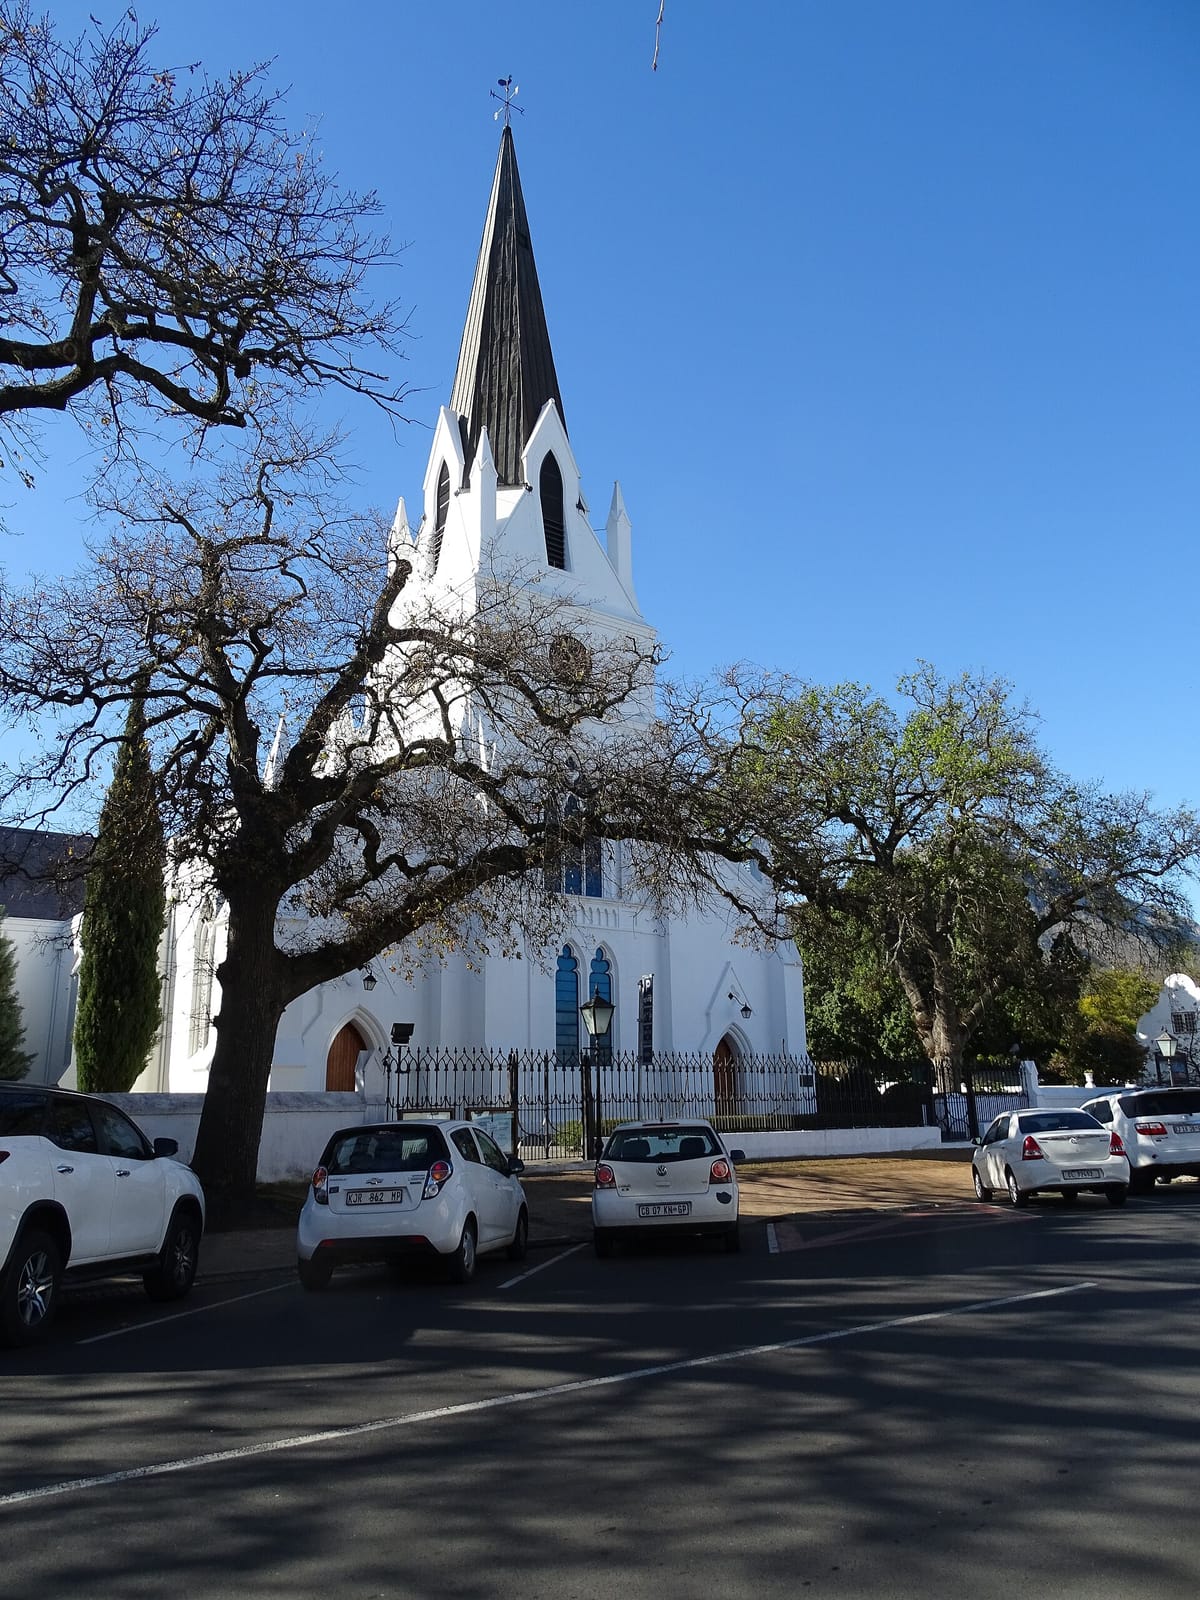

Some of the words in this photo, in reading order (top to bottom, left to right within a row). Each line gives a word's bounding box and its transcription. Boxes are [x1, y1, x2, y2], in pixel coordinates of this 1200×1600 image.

[348, 1193, 363, 1204] KJR
[369, 1192, 384, 1202] 862
[391, 1191, 402, 1201] MP
[677, 1205, 687, 1214] GP
